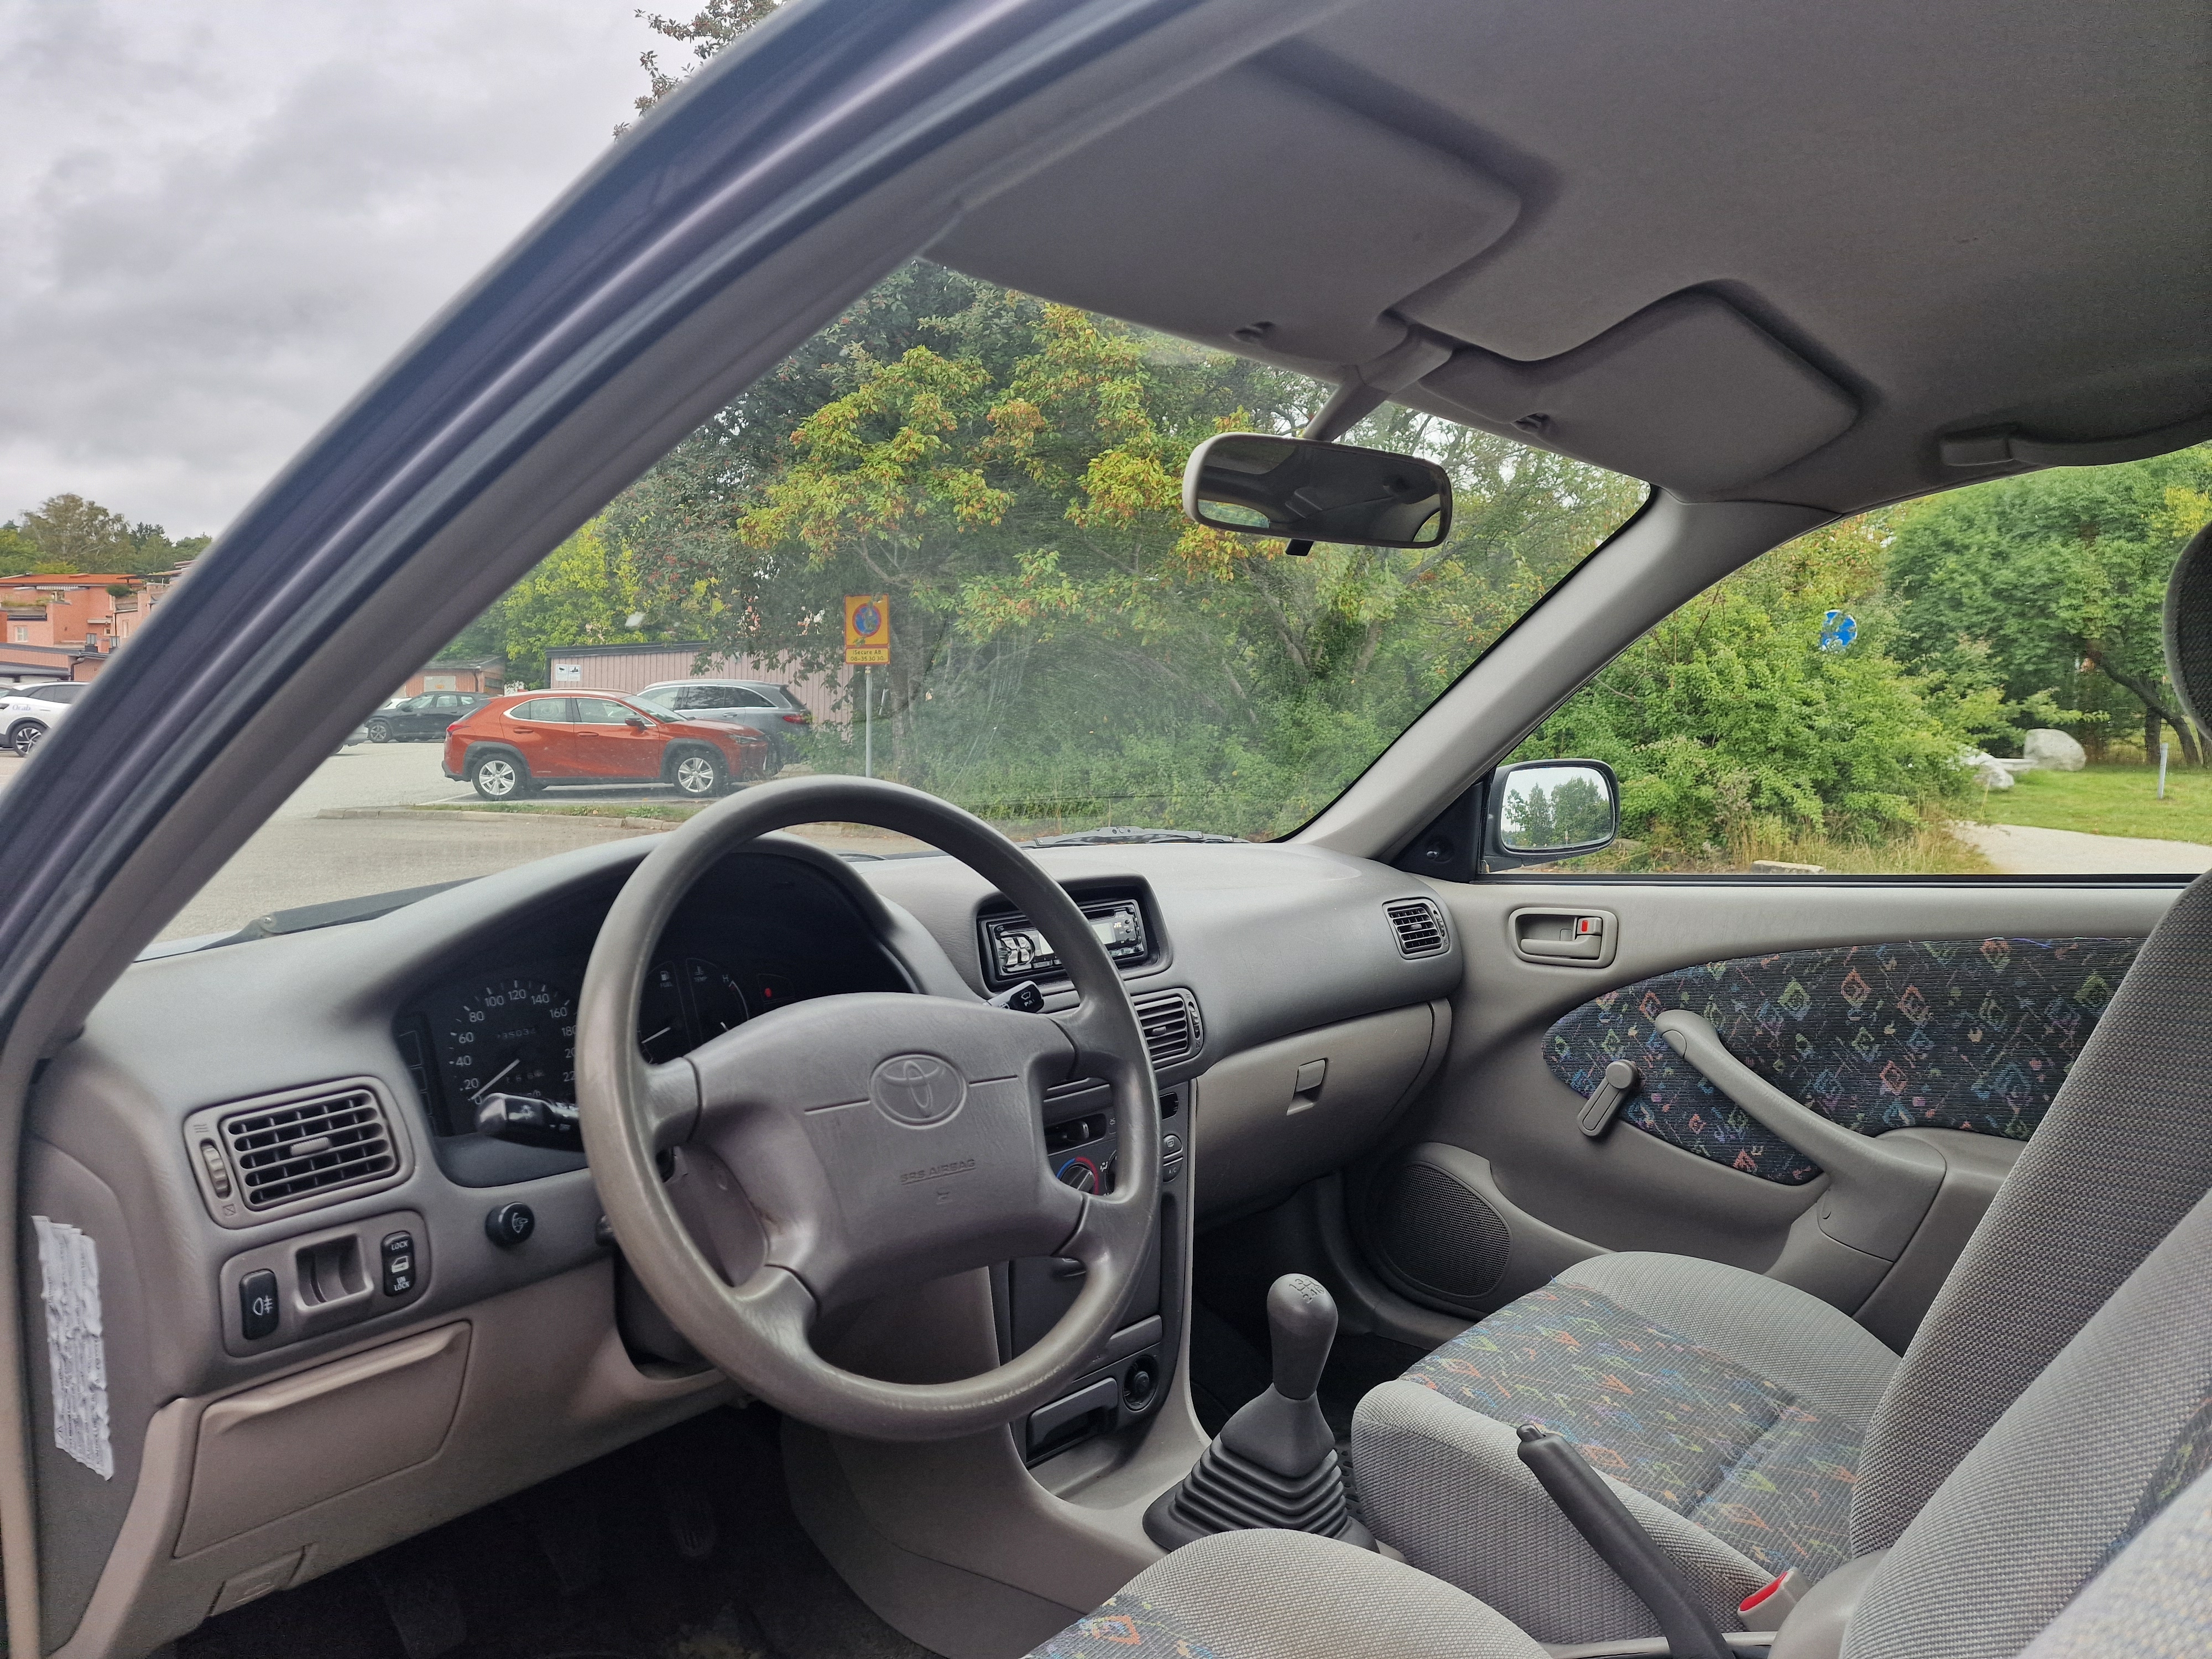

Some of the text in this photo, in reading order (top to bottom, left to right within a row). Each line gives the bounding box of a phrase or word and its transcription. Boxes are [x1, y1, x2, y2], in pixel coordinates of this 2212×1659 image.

[722, 974, 729, 983] H
[508, 989, 526, 1000] 120
[531, 993, 550, 1005] 140
[485, 995, 504, 1007] 100
[469, 1010, 485, 1022] 80
[549, 1006, 567, 1018] 160
[458, 1031, 474, 1044] 60
[565, 1047, 575, 1058] 20
[456, 1055, 471, 1066] 40
[563, 1071, 575, 1082] 22
[463, 1078, 479, 1090] 20
[474, 1095, 482, 1105] 0
[900, 1159, 975, 1183] SRS AIRBAG
[391, 1240, 409, 1251] LOCK
[393, 1281, 410, 1291] LOCK
[1303, 1293, 1313, 1304] 2
